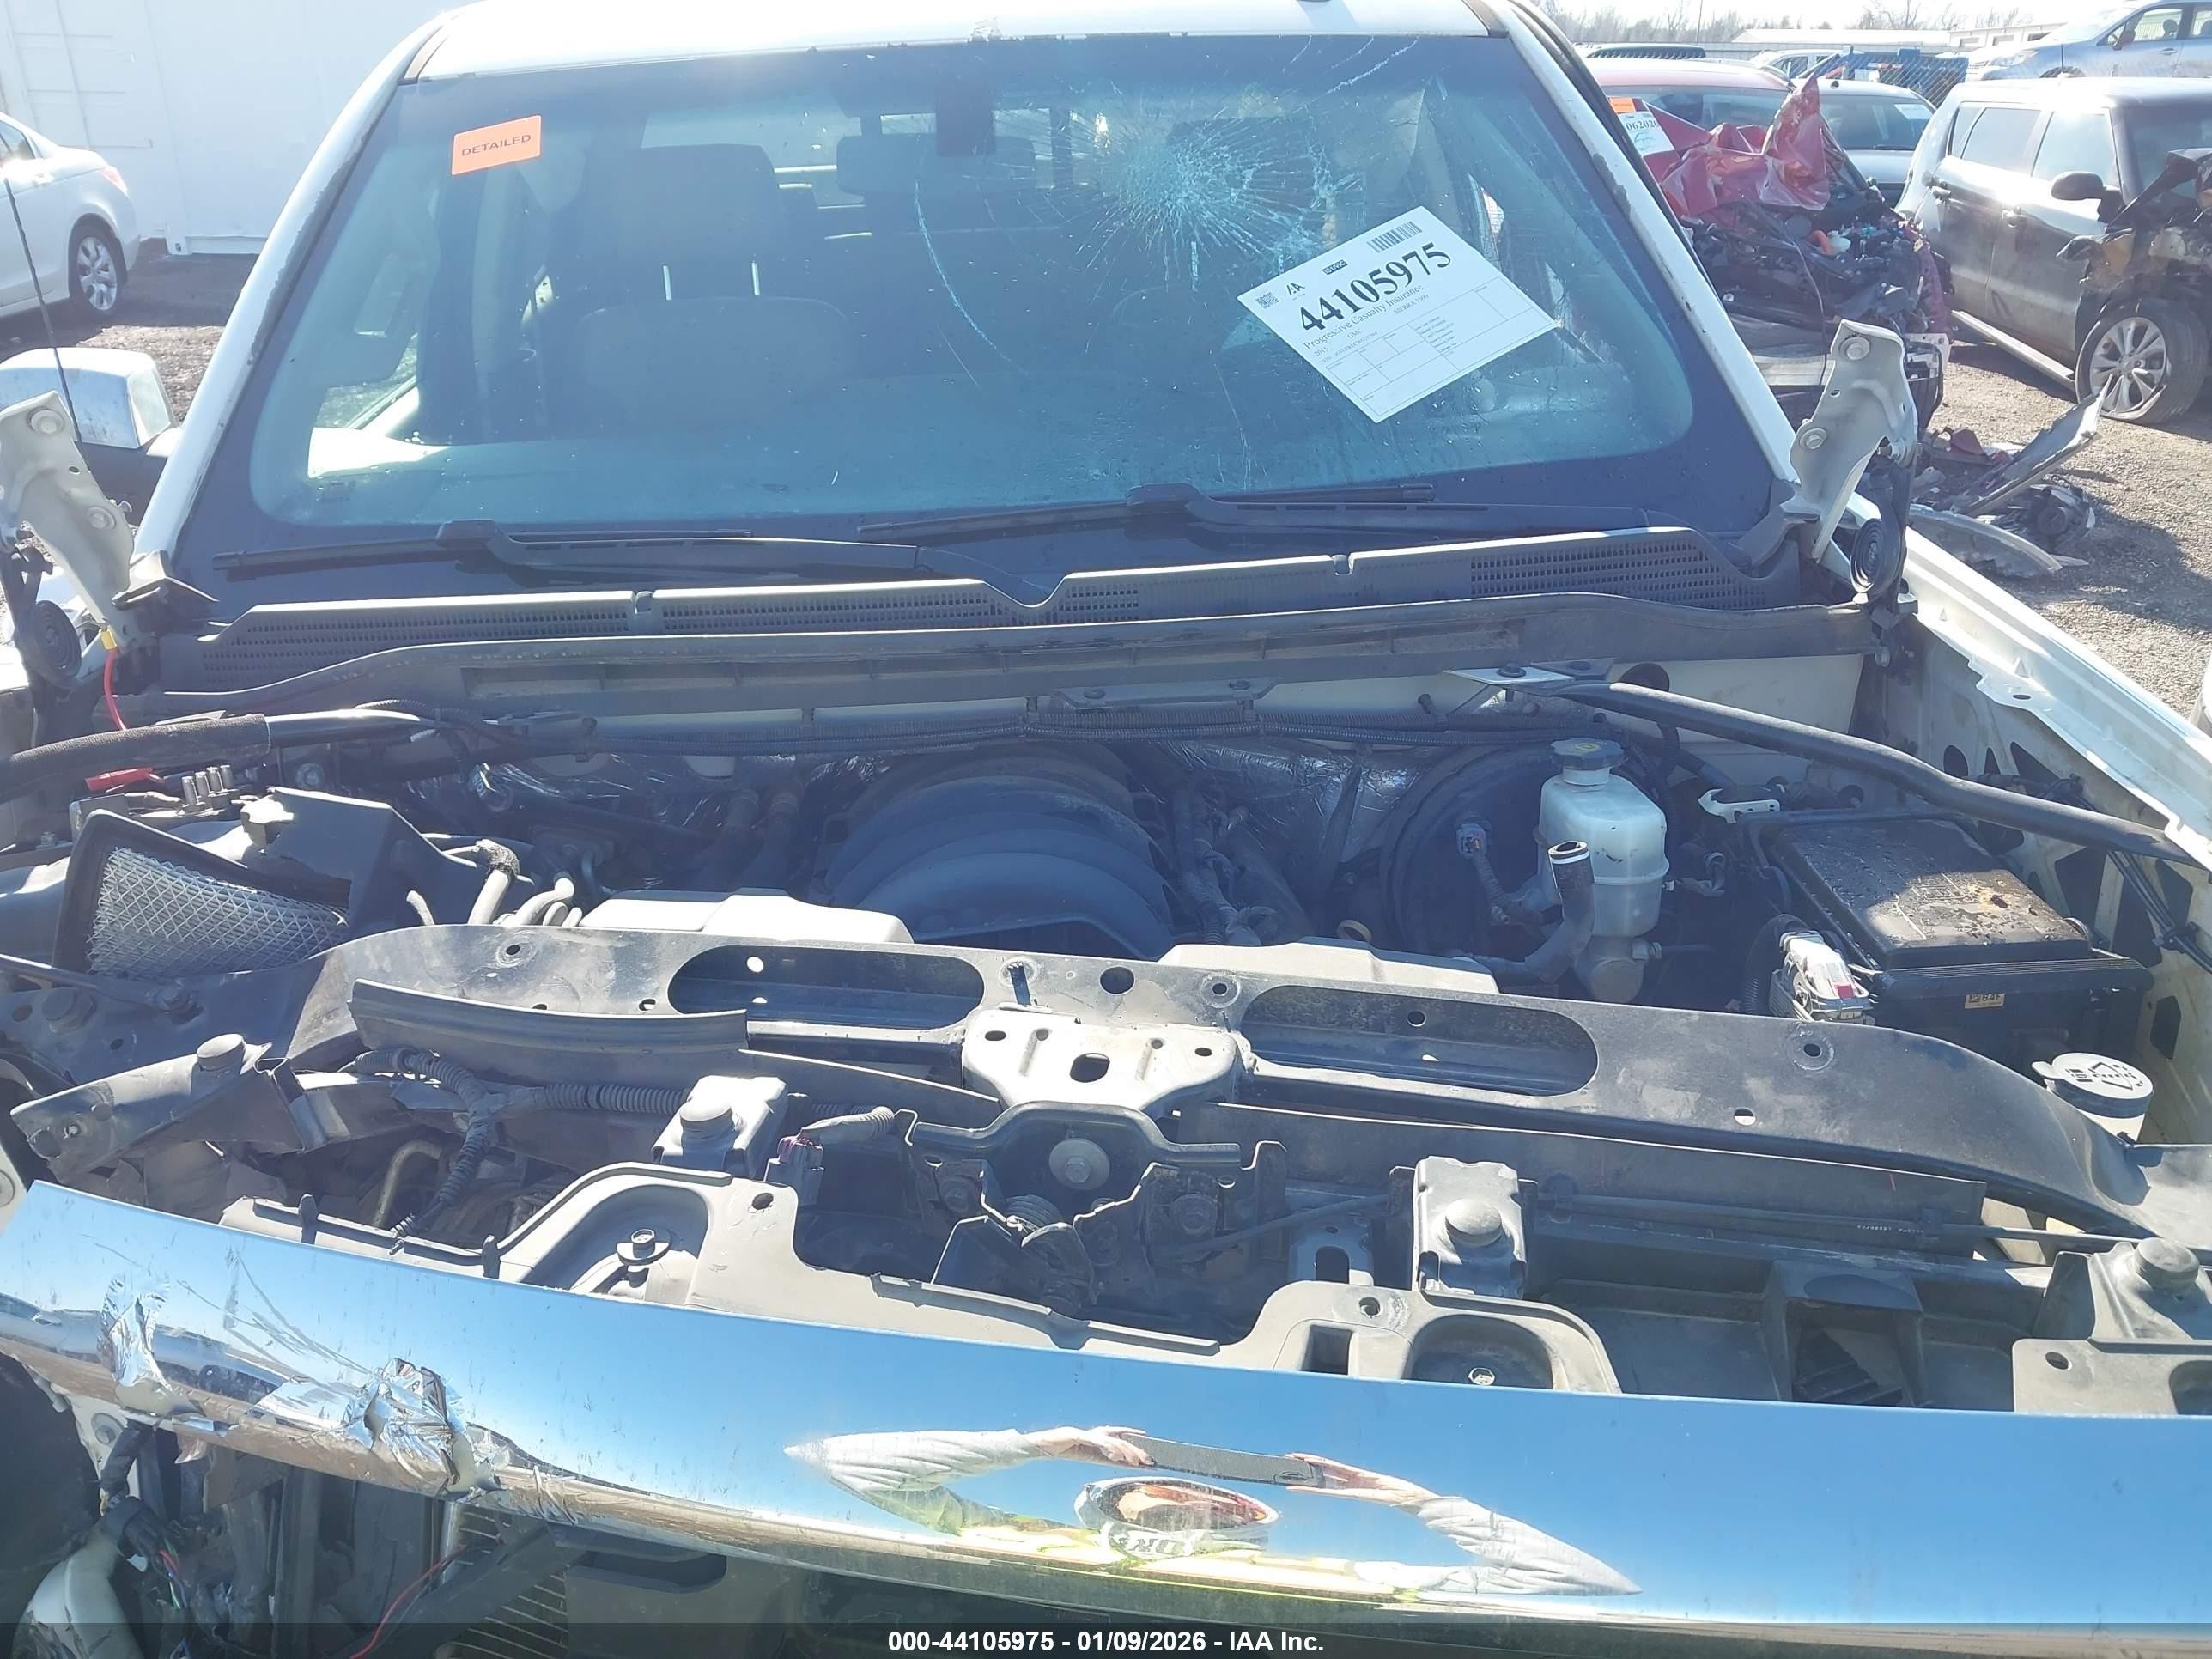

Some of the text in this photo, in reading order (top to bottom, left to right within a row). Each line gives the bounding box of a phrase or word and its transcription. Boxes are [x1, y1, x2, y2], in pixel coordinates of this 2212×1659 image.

[461, 134, 532, 156] DETAILED
[1299, 241, 1451, 331] 44105975
[1303, 321, 1352, 349] Progressive
[1351, 302, 1387, 325] Casualty
[1385, 284, 1424, 307] Insurance
